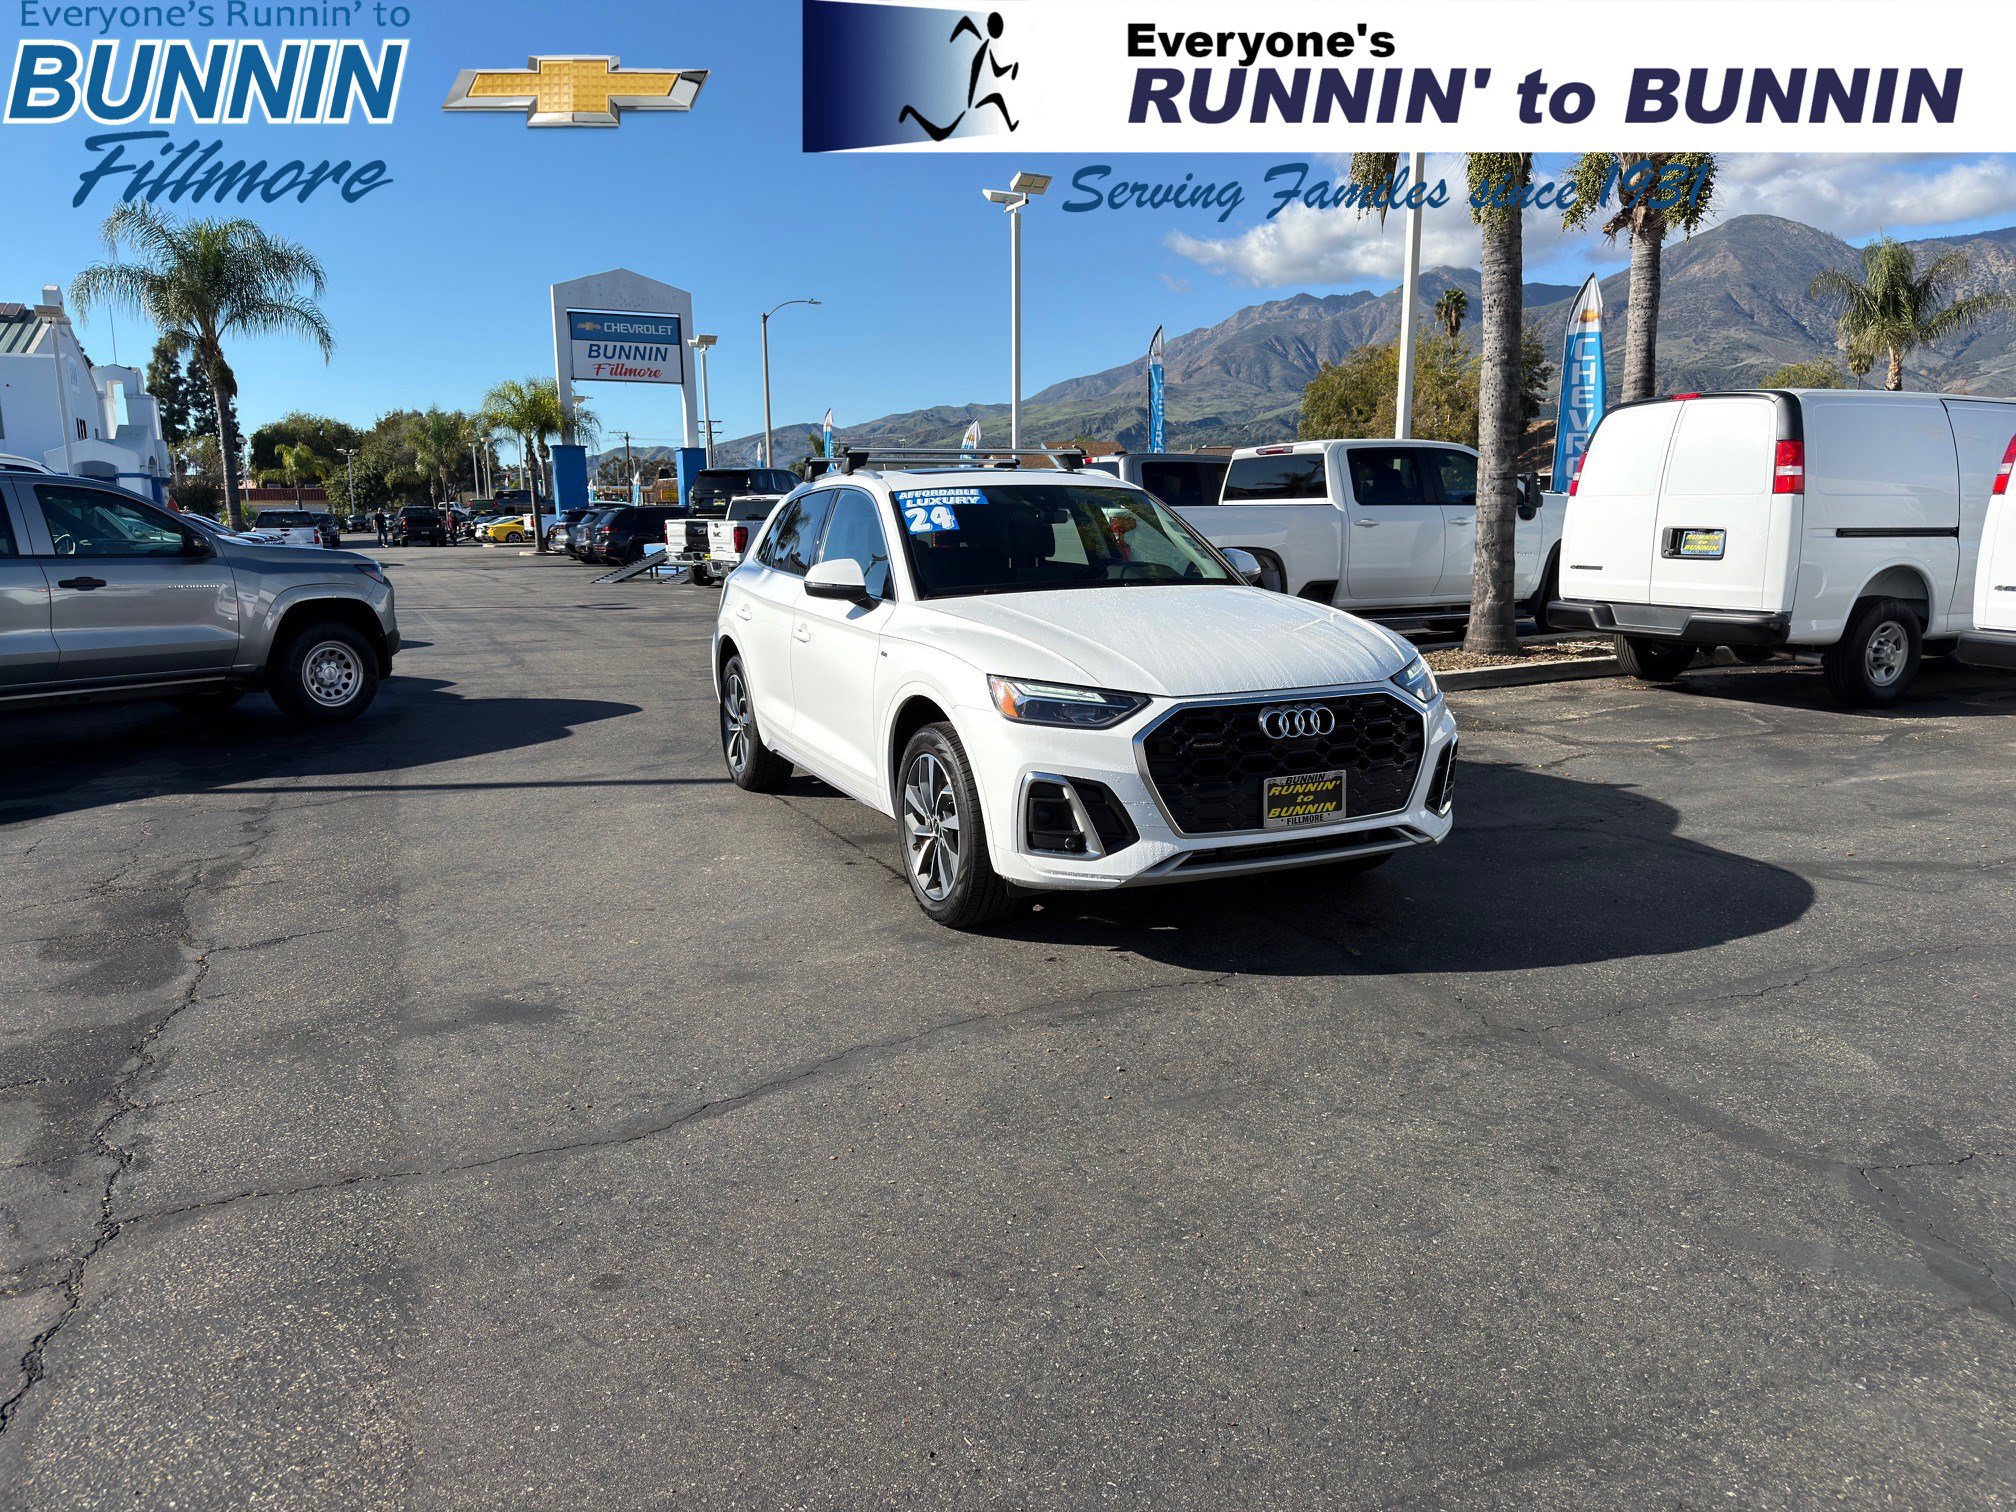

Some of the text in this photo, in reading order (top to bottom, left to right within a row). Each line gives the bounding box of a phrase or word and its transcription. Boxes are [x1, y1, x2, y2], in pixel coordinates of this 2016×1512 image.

[603, 322, 673, 336] CHEVROLET
[587, 343, 668, 362] BUNNIN
[592, 362, 662, 379] Fillmore
[898, 488, 980, 500] AFFORDABLE
[905, 496, 981, 508] LUXURY
[904, 505, 956, 532] 24
[1285, 773, 1326, 785] BUNNIN
[1268, 780, 1341, 796] RUNNIN'
[1296, 794, 1315, 803] to
[1268, 801, 1337, 819] BUNNIN
[1286, 813, 1325, 826] FILLMORE
